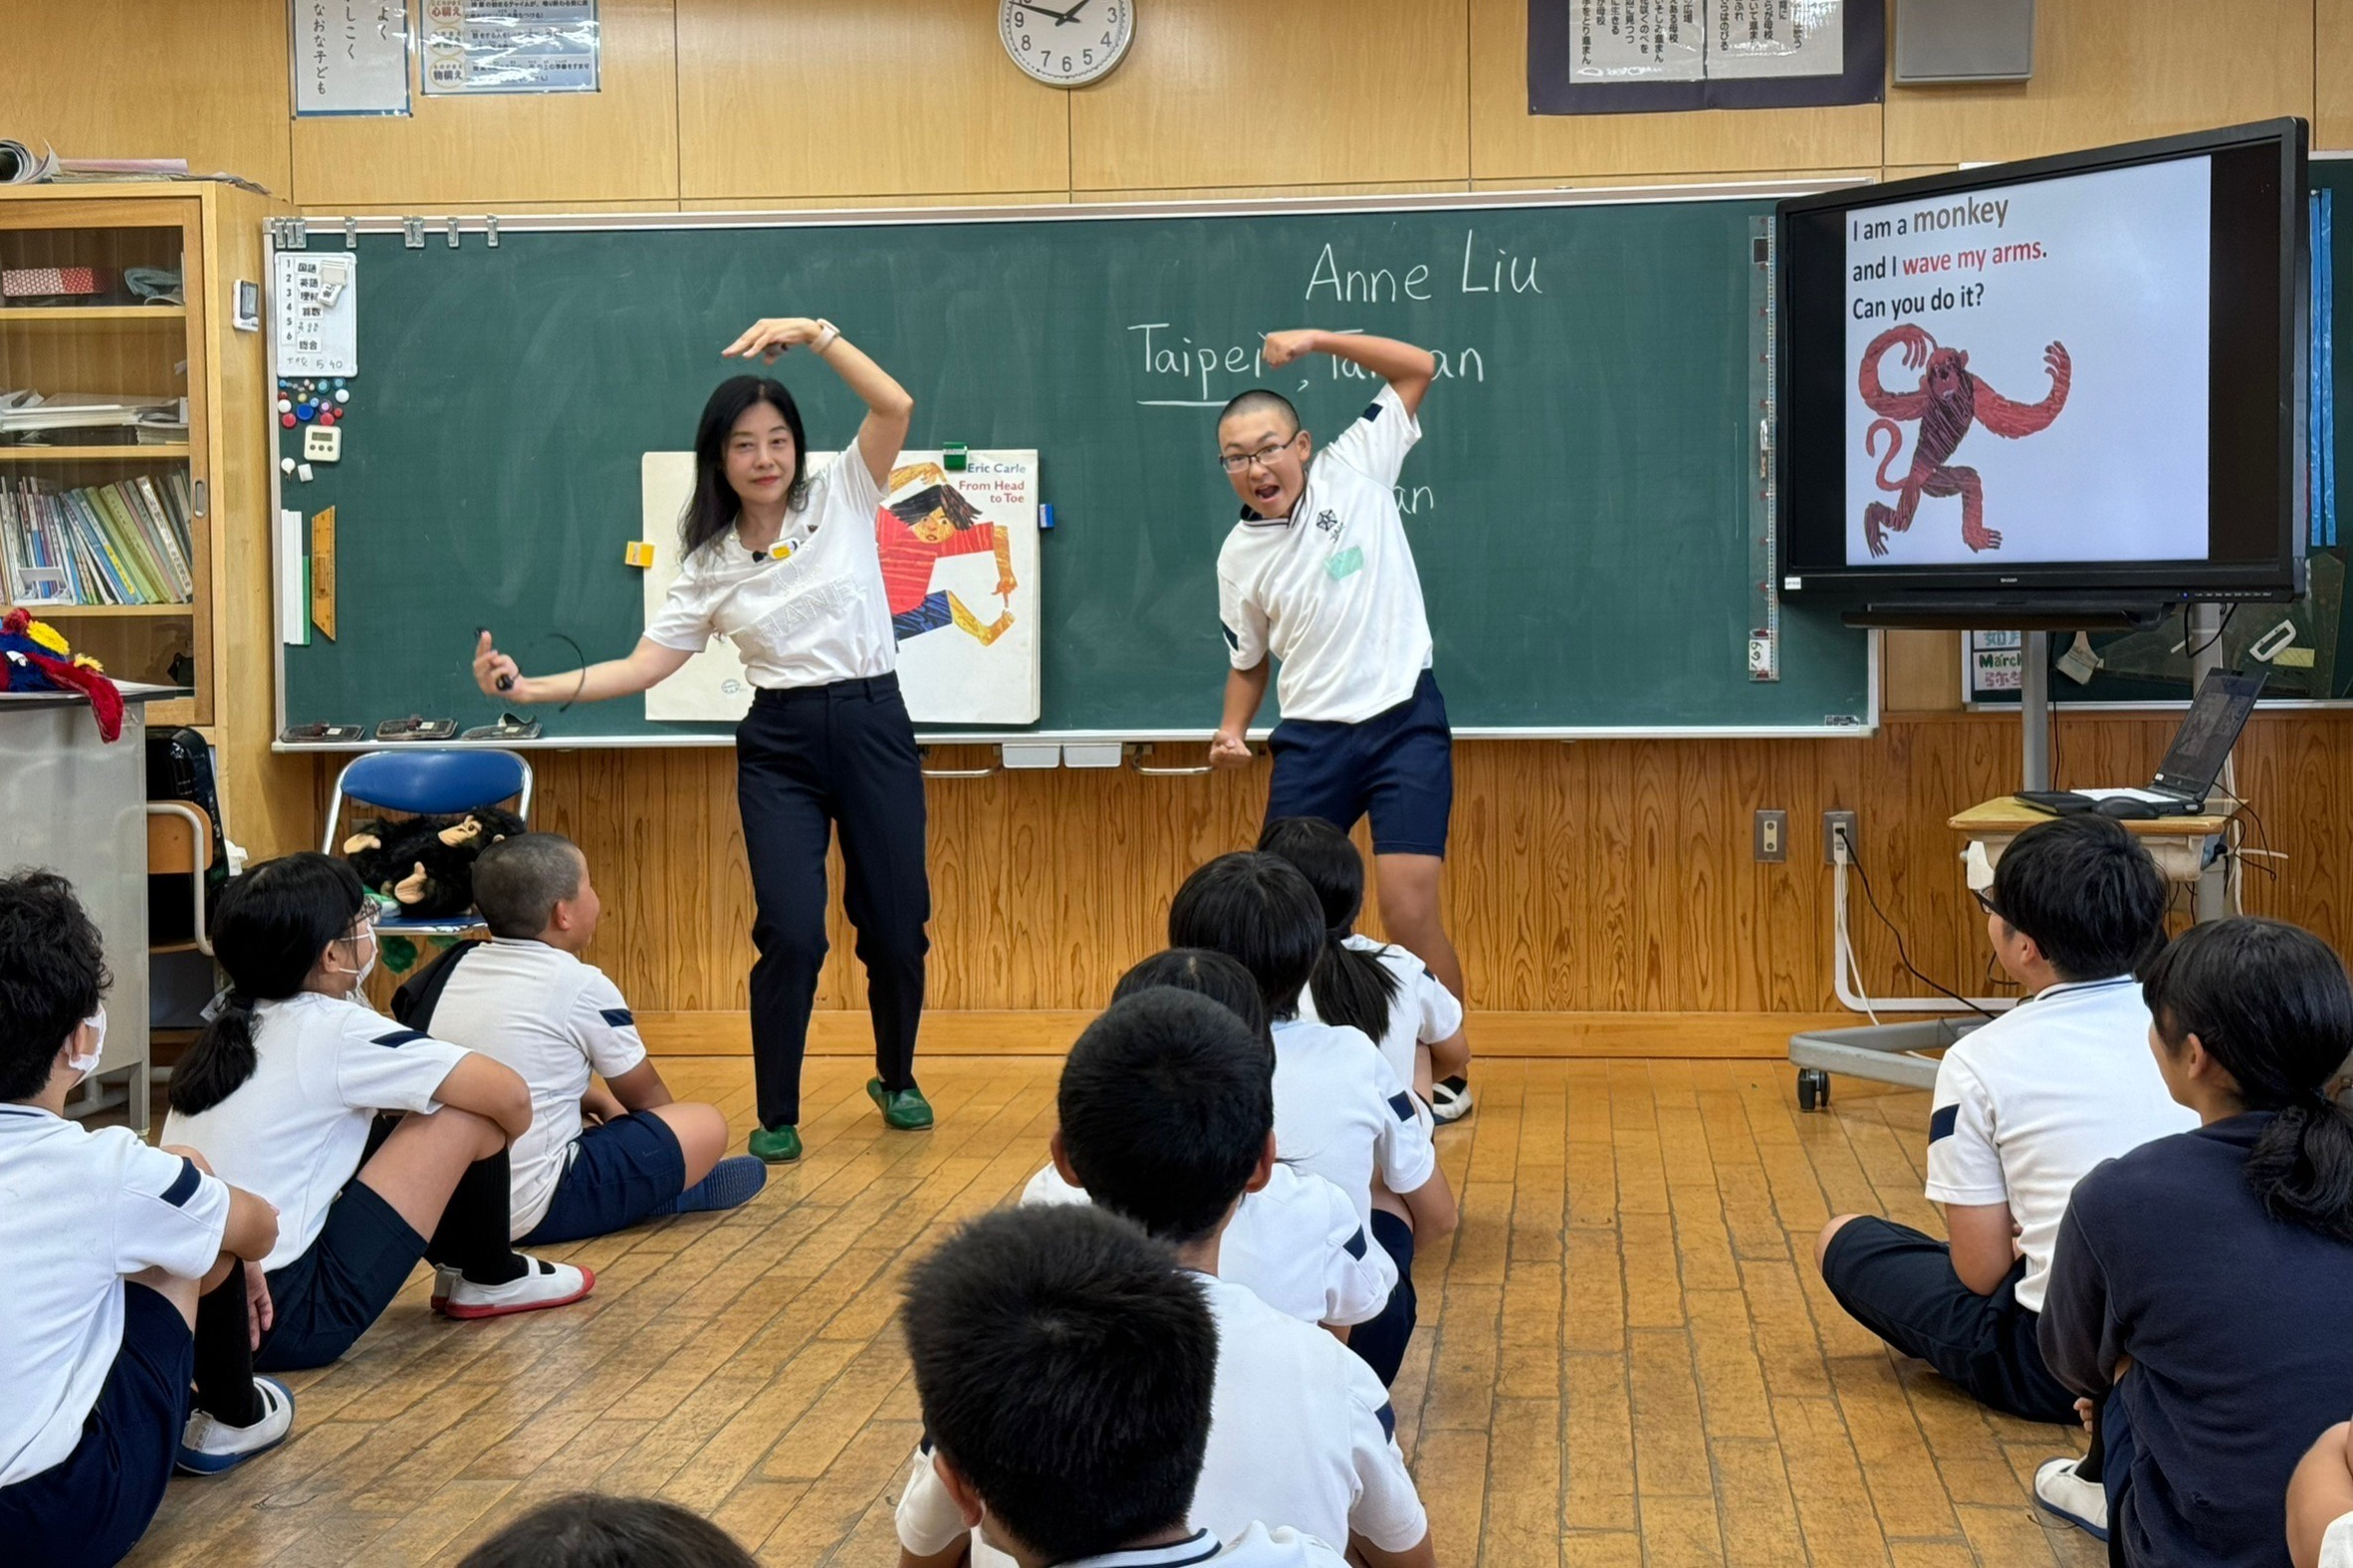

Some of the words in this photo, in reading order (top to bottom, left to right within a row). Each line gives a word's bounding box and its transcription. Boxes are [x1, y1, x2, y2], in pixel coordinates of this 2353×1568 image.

[1107, 7, 1118, 24] 3
[1734, 0, 1745, 21] ふれ
[377, 0, 389, 41] よく
[1014, 11, 1025, 29] 9
[1748, 0, 1760, 44] いて進ま
[345, 0, 356, 60] しこく
[313, 0, 329, 96] なおな子ども
[1021, 34, 1032, 52] 8
[1100, 31, 1112, 48] 4
[1041, 50, 1052, 68] 7
[1061, 56, 1072, 73] 6
[1082, 48, 1093, 66] 5
[1853, 220, 1858, 242] I
[1863, 220, 1891, 240] am
[1897, 218, 1908, 236] a
[1913, 196, 2009, 233] monkey
[286, 259, 291, 269] 1
[297, 263, 318, 274] 国語
[1305, 242, 1432, 303] Anne
[1462, 228, 1543, 294] Liu
[1852, 255, 1886, 282] and
[1892, 256, 1897, 277] I
[1902, 253, 1952, 276] wave
[1957, 248, 1988, 273] my
[1992, 241, 2048, 265] arms.
[286, 274, 292, 283] 2
[286, 288, 292, 297] 3
[1852, 298, 1886, 321] Can
[1891, 296, 1925, 322] you
[1930, 287, 1955, 312] do
[1961, 282, 1985, 309] it?
[286, 317, 293, 327] 5
[286, 332, 293, 340] 6
[329, 358, 344, 369] 40
[1332, 328, 1486, 382] Taan
[967, 462, 991, 474] Eric
[994, 463, 1027, 474] Carle
[959, 480, 991, 491] From
[994, 480, 1025, 491] Head
[990, 494, 1003, 504] to
[1003, 492, 1025, 504] Toe
